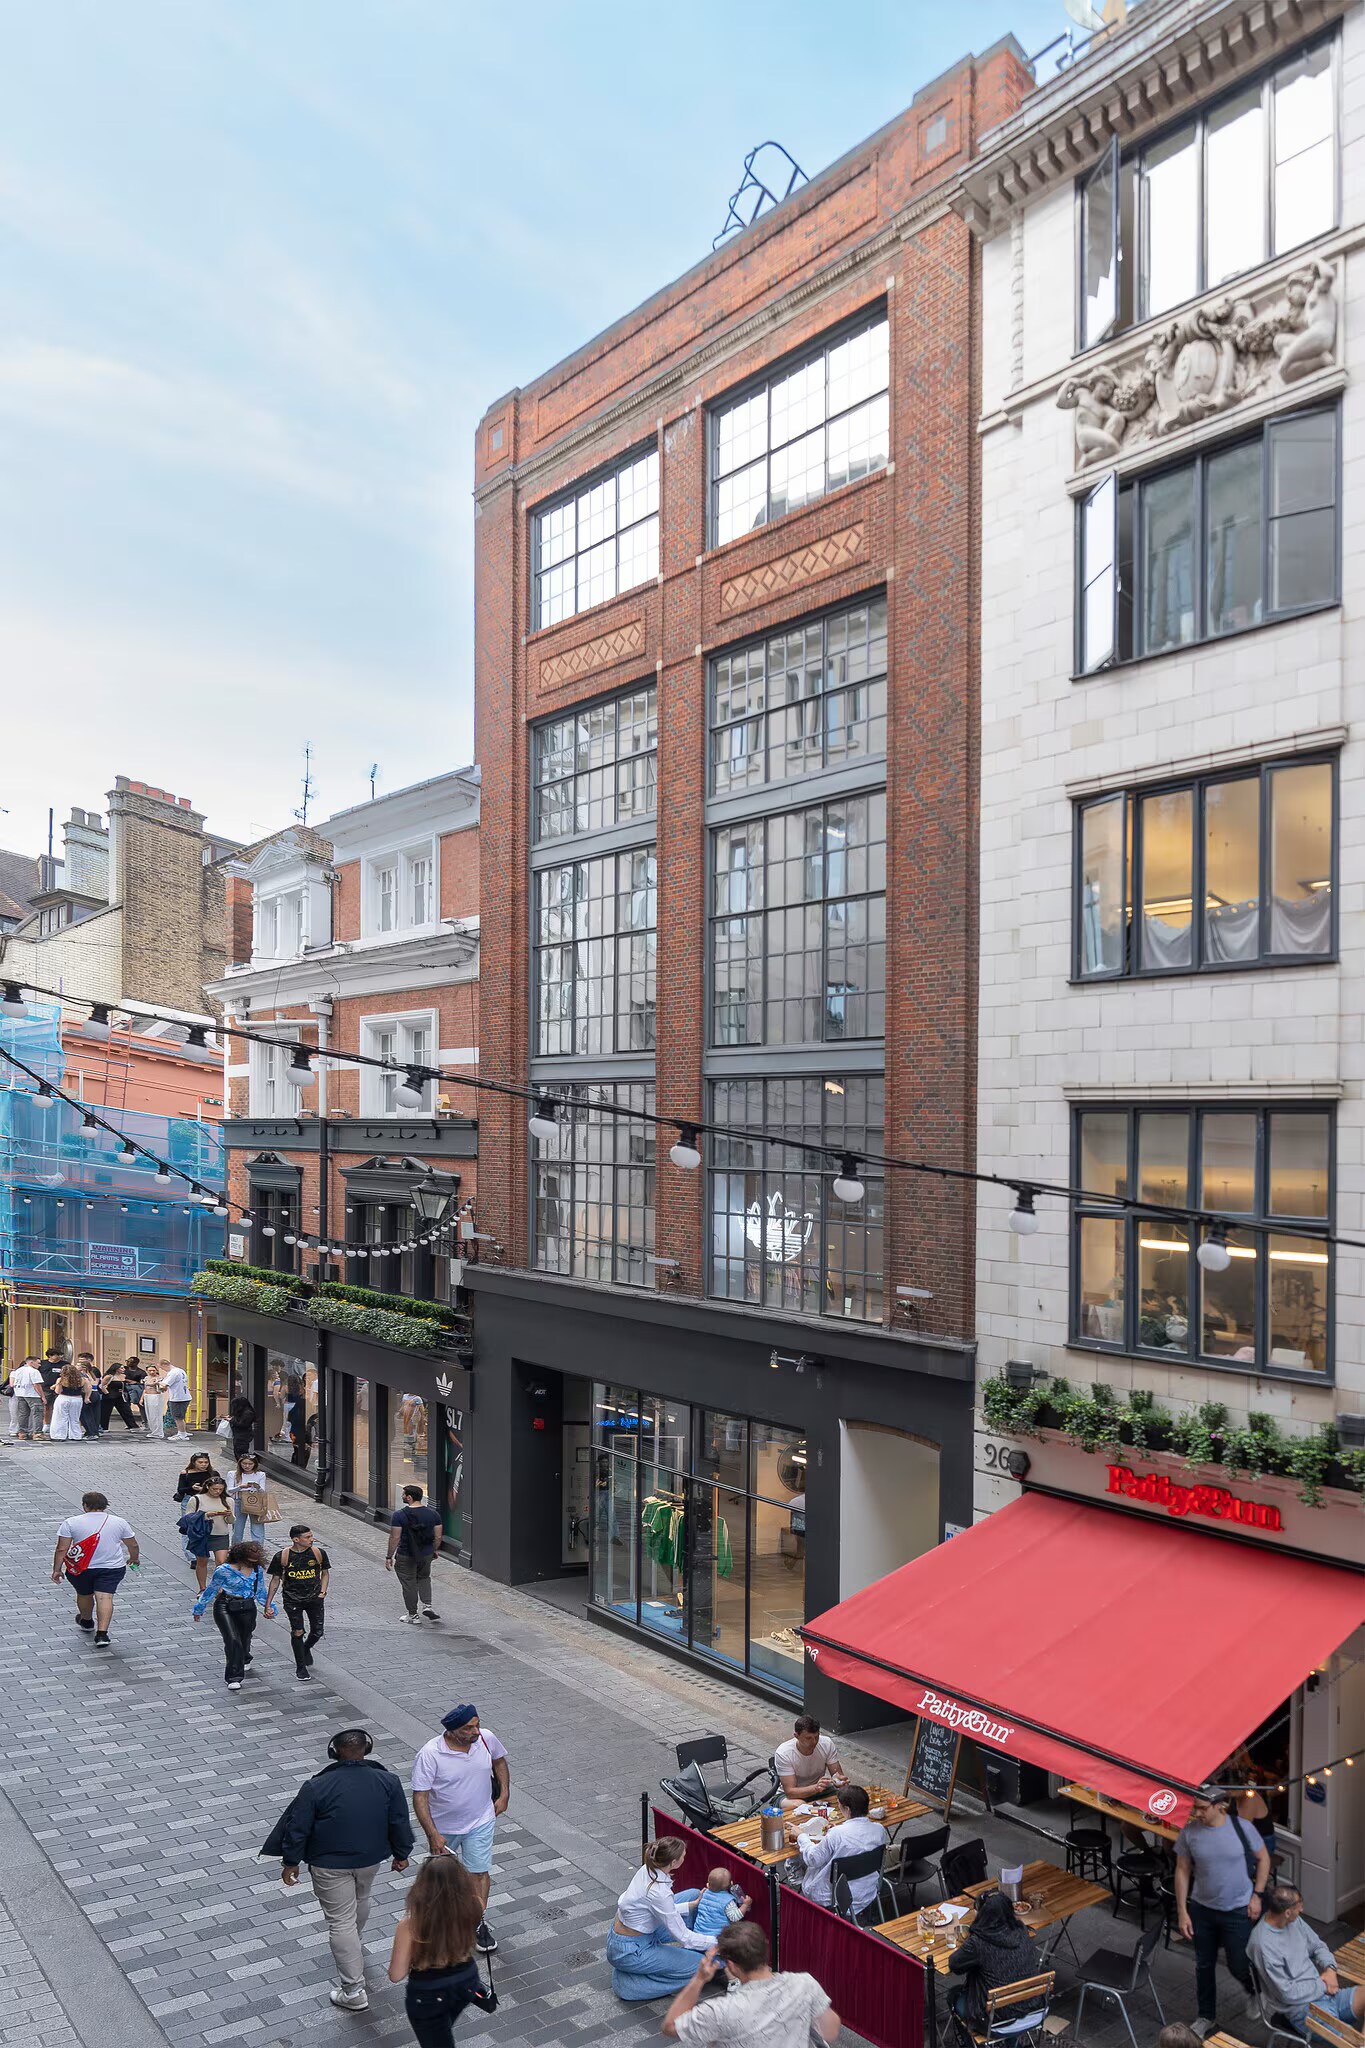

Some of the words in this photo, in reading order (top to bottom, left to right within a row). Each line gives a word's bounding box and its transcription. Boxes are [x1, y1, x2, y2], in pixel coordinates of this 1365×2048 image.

[91, 1244, 135, 1255] WARNING
[91, 1262, 136, 1271] SCAFFOLDING
[984, 1443, 1010, 1470] 26
[1105, 1464, 1285, 1532] Patty&Bun
[288, 1569, 316, 1578] QATAR
[917, 1690, 1007, 1744] Patty&Bun
